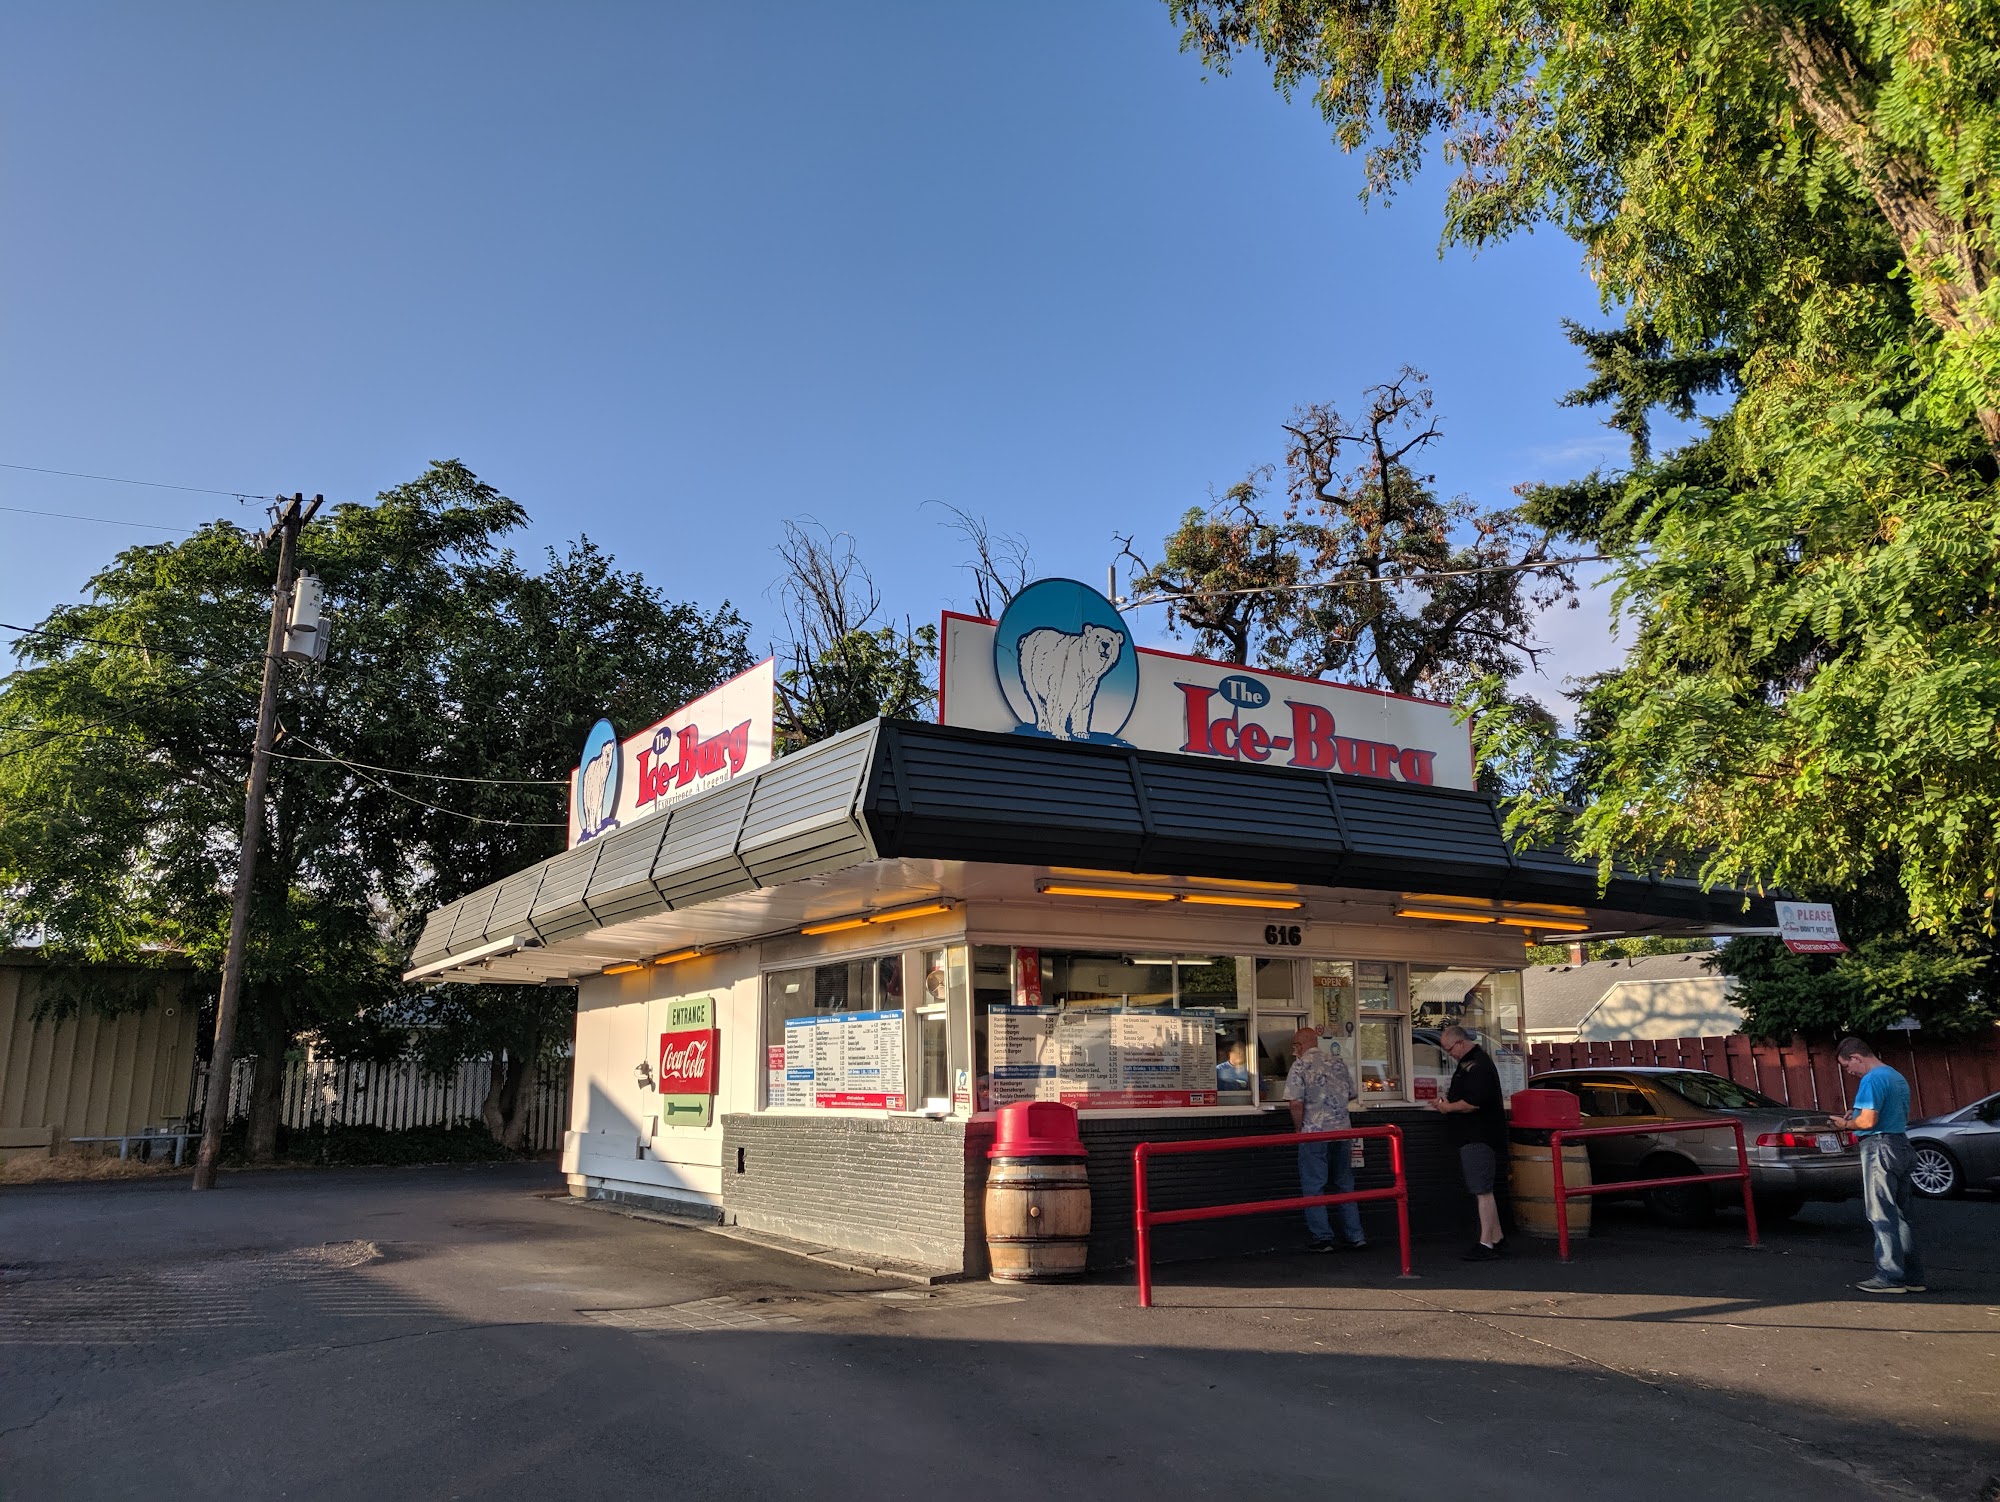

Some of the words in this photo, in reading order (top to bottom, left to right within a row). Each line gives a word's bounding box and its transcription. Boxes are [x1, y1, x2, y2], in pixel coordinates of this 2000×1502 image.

[1227, 680, 1263, 704] The
[655, 732, 669, 751] The
[635, 718, 752, 808] Ice-Burg
[657, 790, 693, 809] Experience
[1797, 909, 1832, 922] PLEASE
[1265, 924, 1302, 946] 616
[1794, 942, 1830, 950] Clearance
[1321, 978, 1342, 986] OPEN
[672, 1005, 705, 1026] ENTRANCE
[662, 1040, 708, 1079] Coca-Cola
